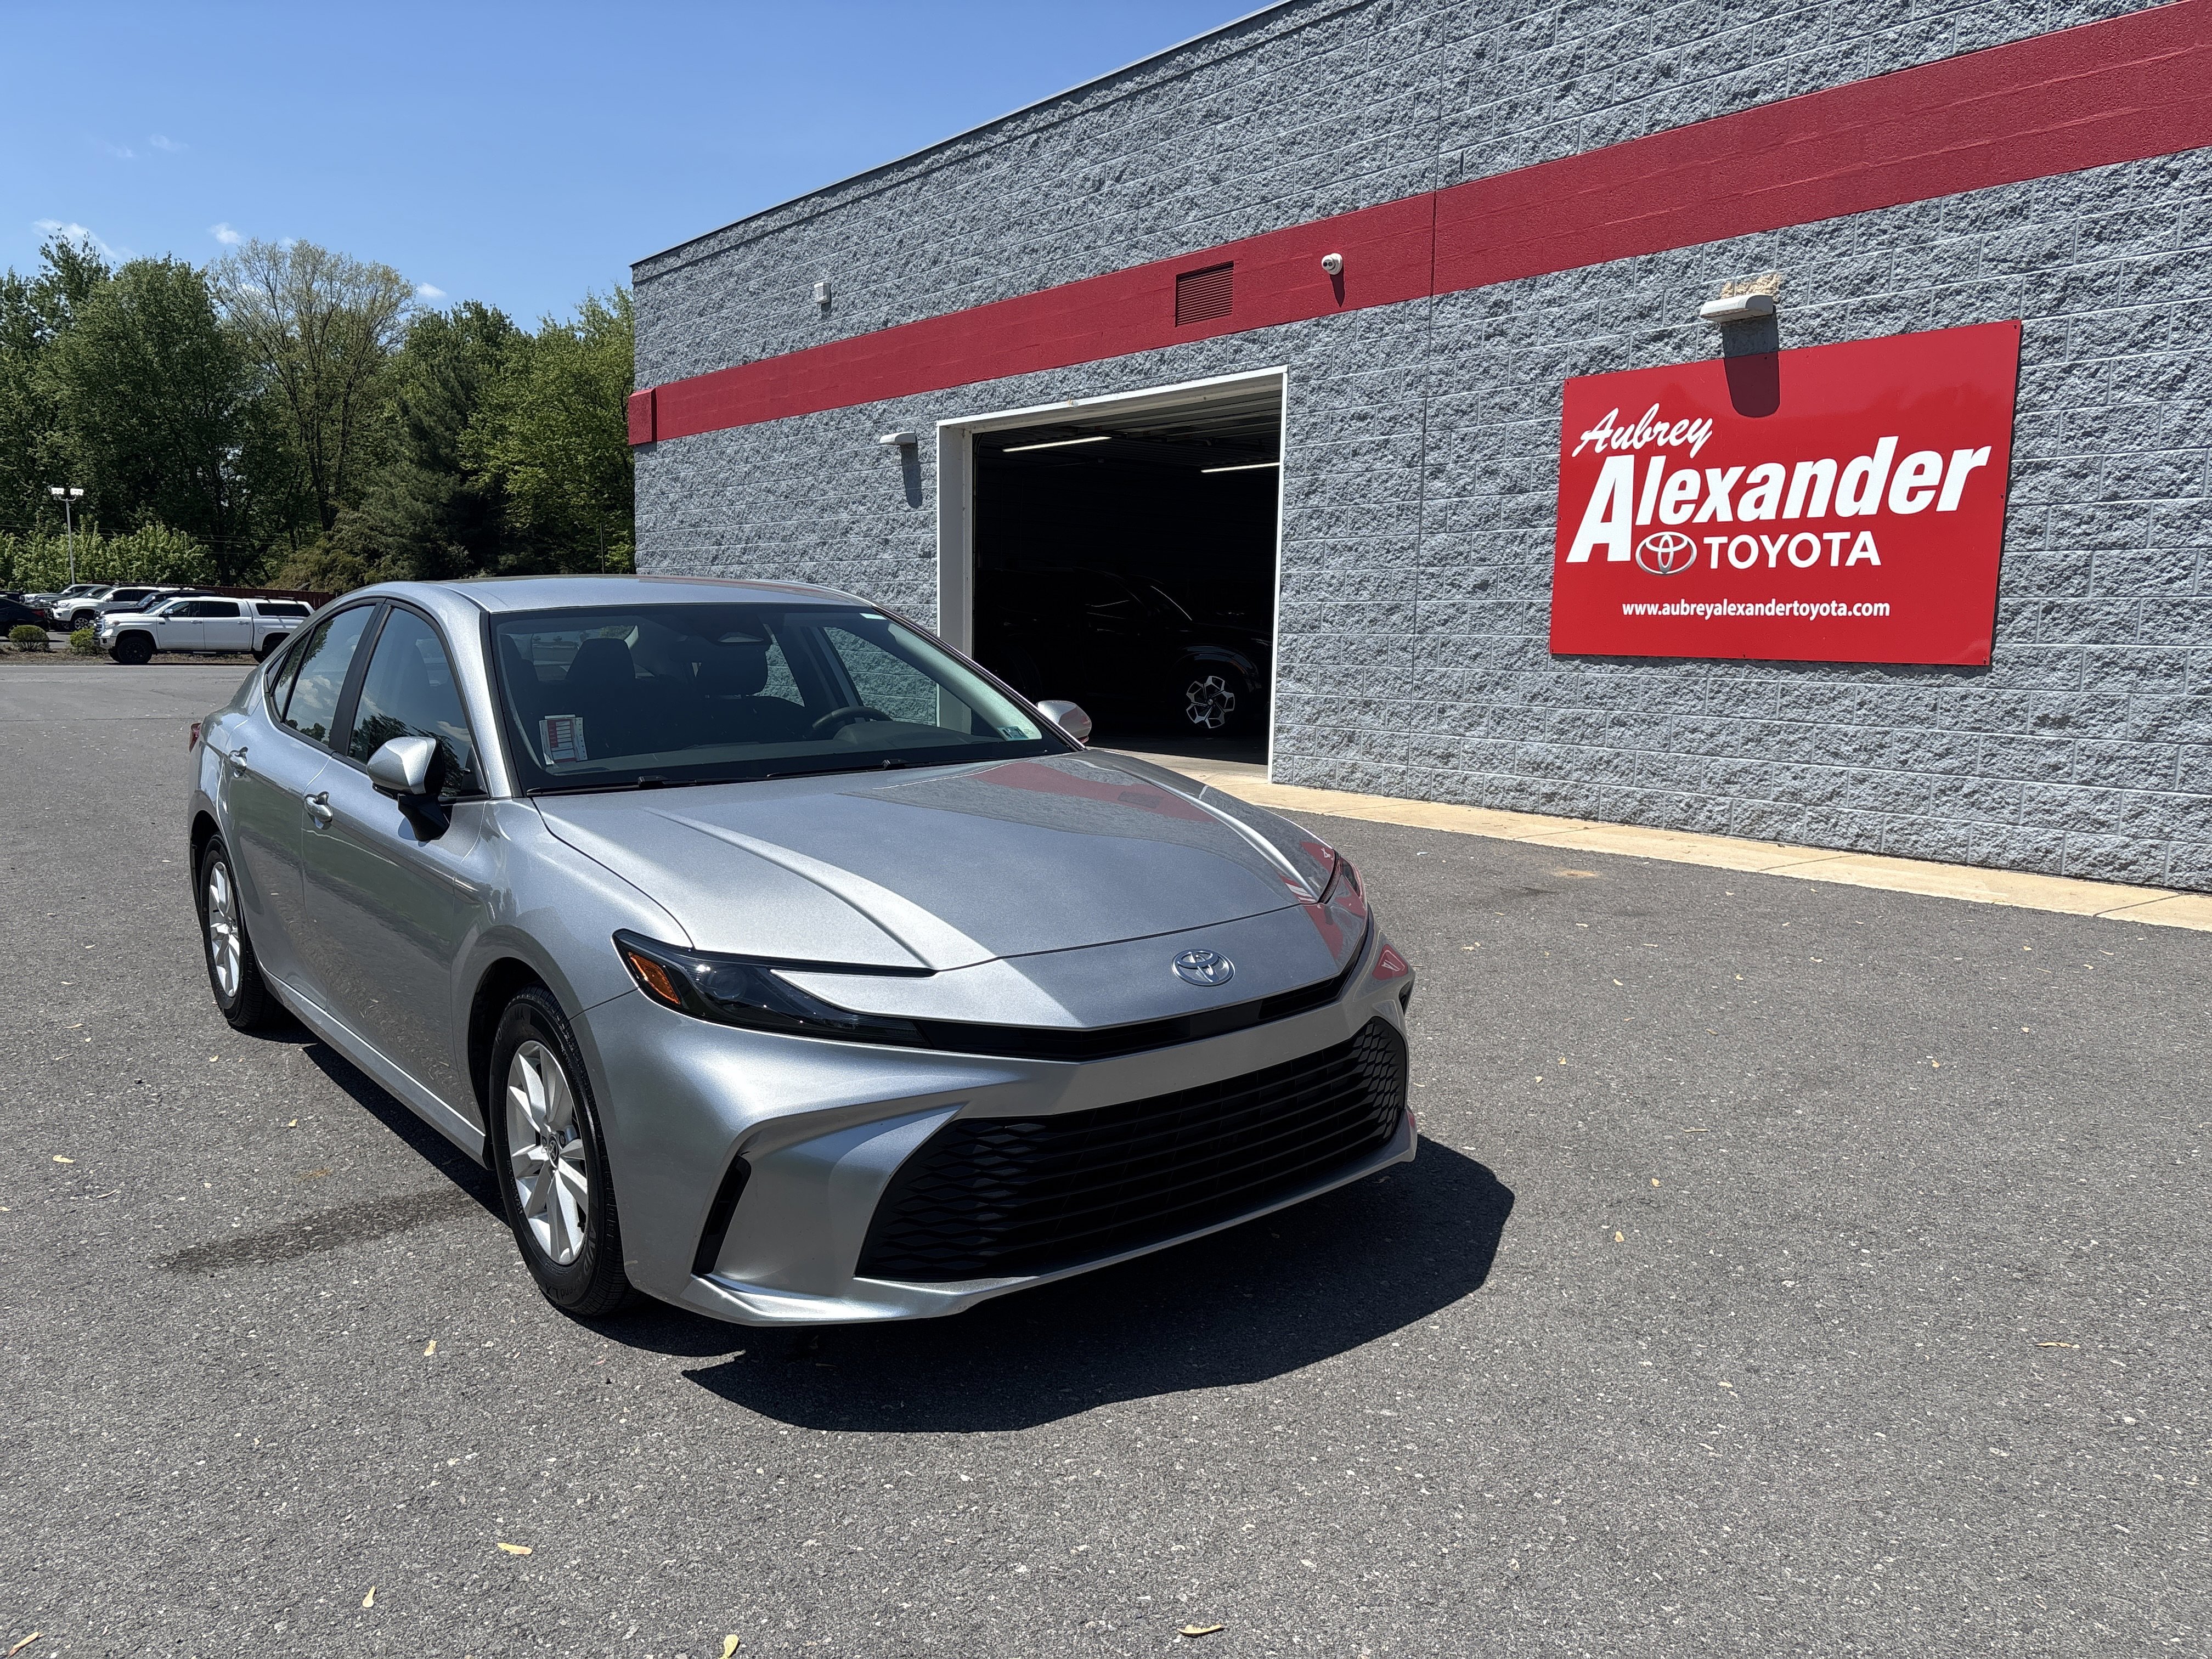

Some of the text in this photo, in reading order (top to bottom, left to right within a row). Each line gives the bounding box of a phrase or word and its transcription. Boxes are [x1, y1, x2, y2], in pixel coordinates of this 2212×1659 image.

[1571, 403, 1713, 459] Aubrey
[1565, 436, 1992, 563] Alexander
[1703, 531, 1882, 569] TOYOTA
[1622, 598, 1890, 621] www.aubreyalexandertoyota.com
